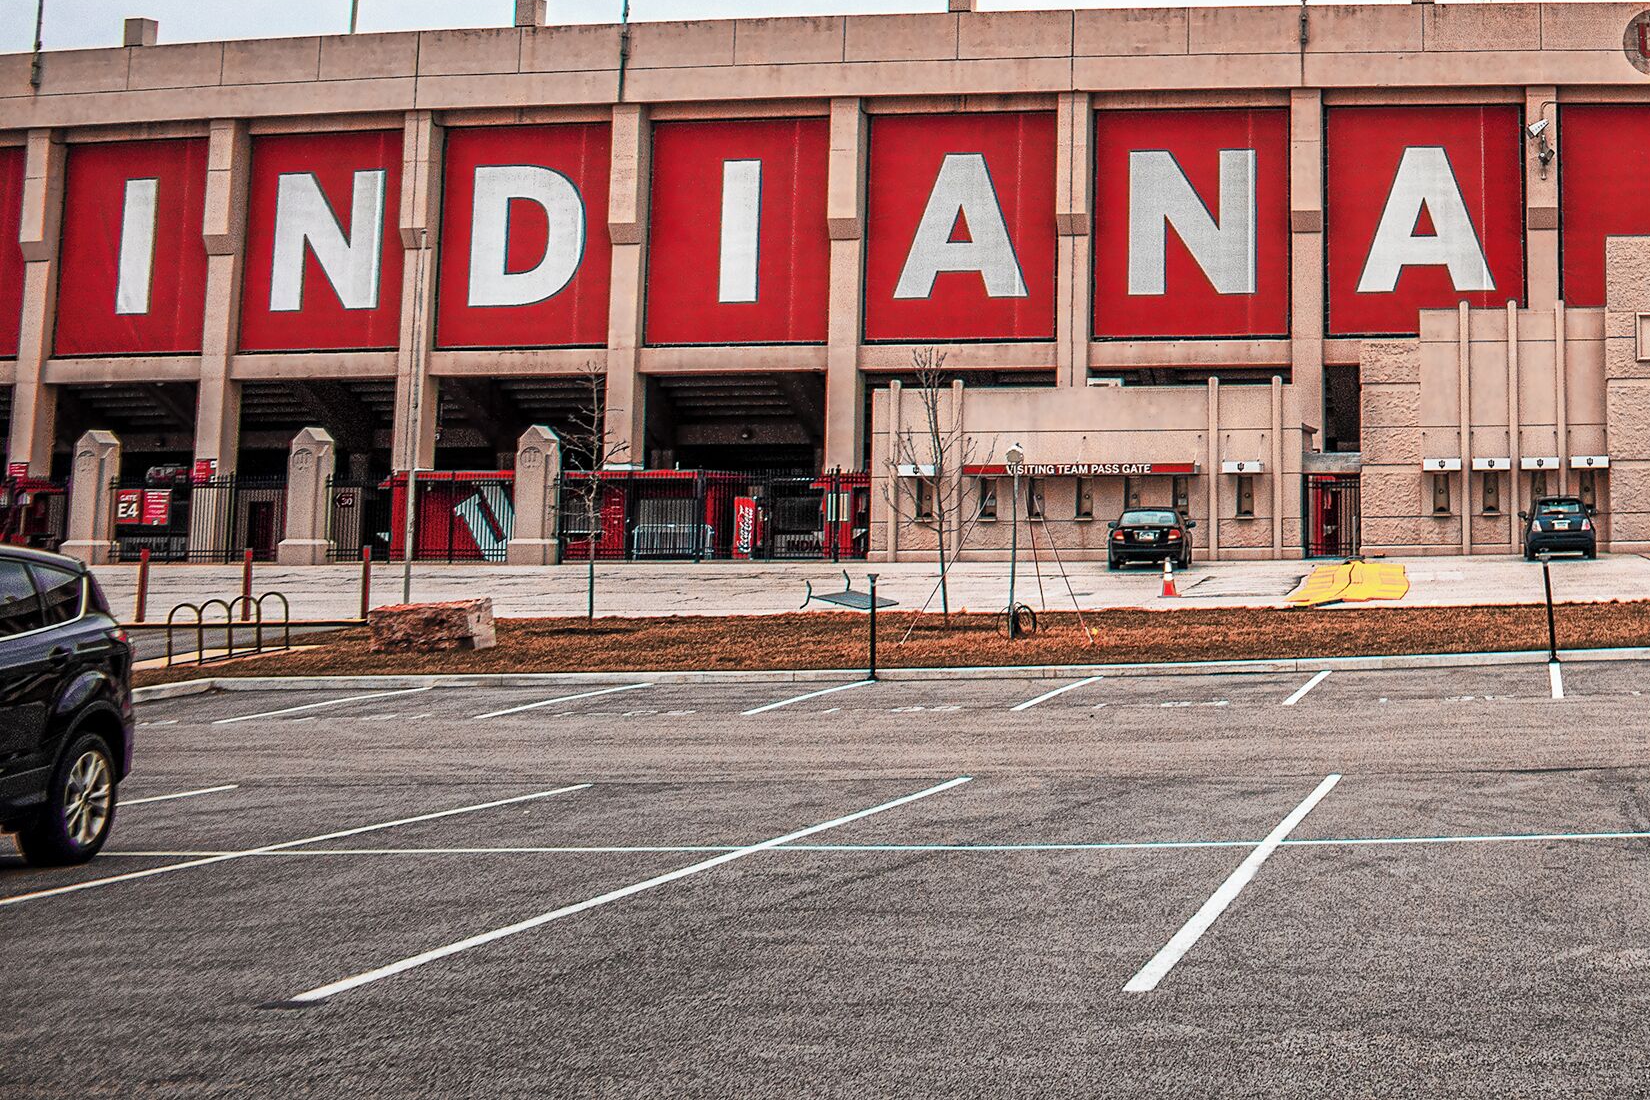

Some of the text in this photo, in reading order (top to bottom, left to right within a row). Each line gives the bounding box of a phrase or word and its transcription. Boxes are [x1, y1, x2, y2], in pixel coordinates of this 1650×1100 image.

[115, 145, 1497, 315] INDIANA
[1006, 463, 1152, 476] VISITING TEAM PASS GATE
[119, 493, 138, 501] GATE
[117, 502, 139, 518] E4
